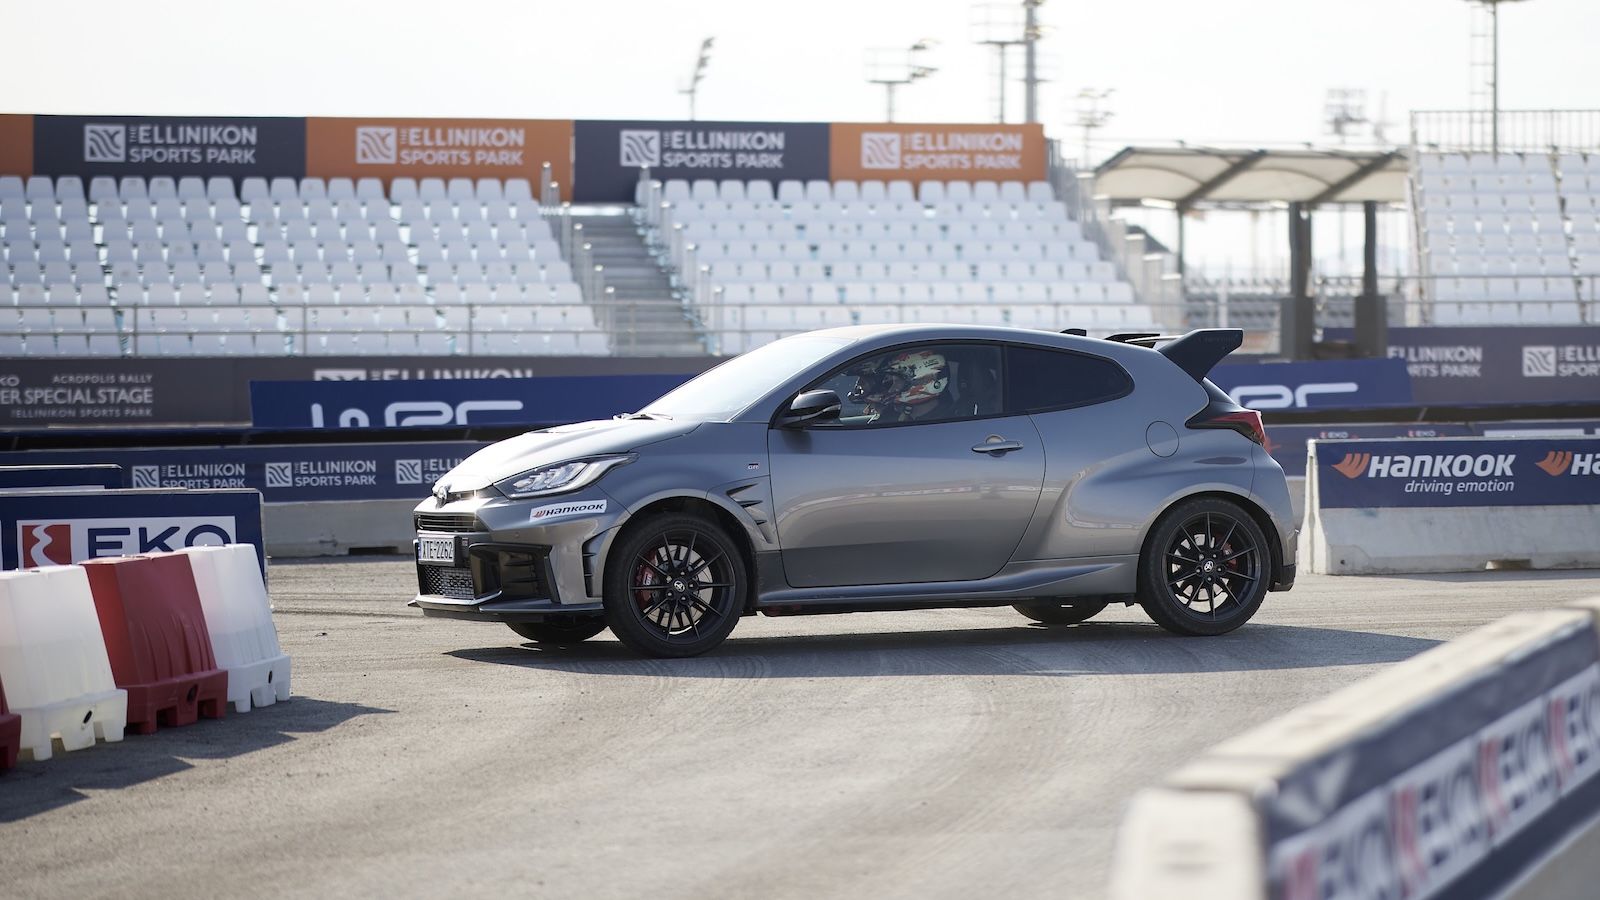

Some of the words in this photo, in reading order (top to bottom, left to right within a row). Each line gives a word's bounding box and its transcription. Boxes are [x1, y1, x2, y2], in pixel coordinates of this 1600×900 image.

[138, 125, 257, 145] ELLINIKON
[409, 127, 525, 147] ELLINIKON
[671, 131, 785, 150] ELLINIKON
[911, 132, 1022, 151] ELLINIKON
[129, 147, 202, 163] SPORTS
[206, 148, 256, 164] PARK
[400, 150, 471, 165] SPORTS
[475, 150, 523, 166] PARK
[662, 152, 732, 168] SPORTS
[735, 153, 784, 168] PARK
[903, 154, 971, 169] SPORTS
[974, 154, 1021, 170] PARK
[1442, 364, 1481, 377] PARK
[52, 375, 116, 384] ACROPOLIS
[118, 374, 153, 383] RALLY
[24, 388, 96, 404] SPECIAL
[97, 388, 153, 404] STAGE
[124, 408, 153, 417] PARK
[168, 464, 246, 477] ELLINIKON
[300, 460, 377, 475] ELLINIKON
[162, 479, 211, 489] SPORTS
[213, 479, 246, 489] PARK
[295, 476, 342, 487] SPORTS
[345, 475, 377, 486] PARK
[1404, 480, 1453, 495] driving
[1456, 479, 1514, 492] emotion
